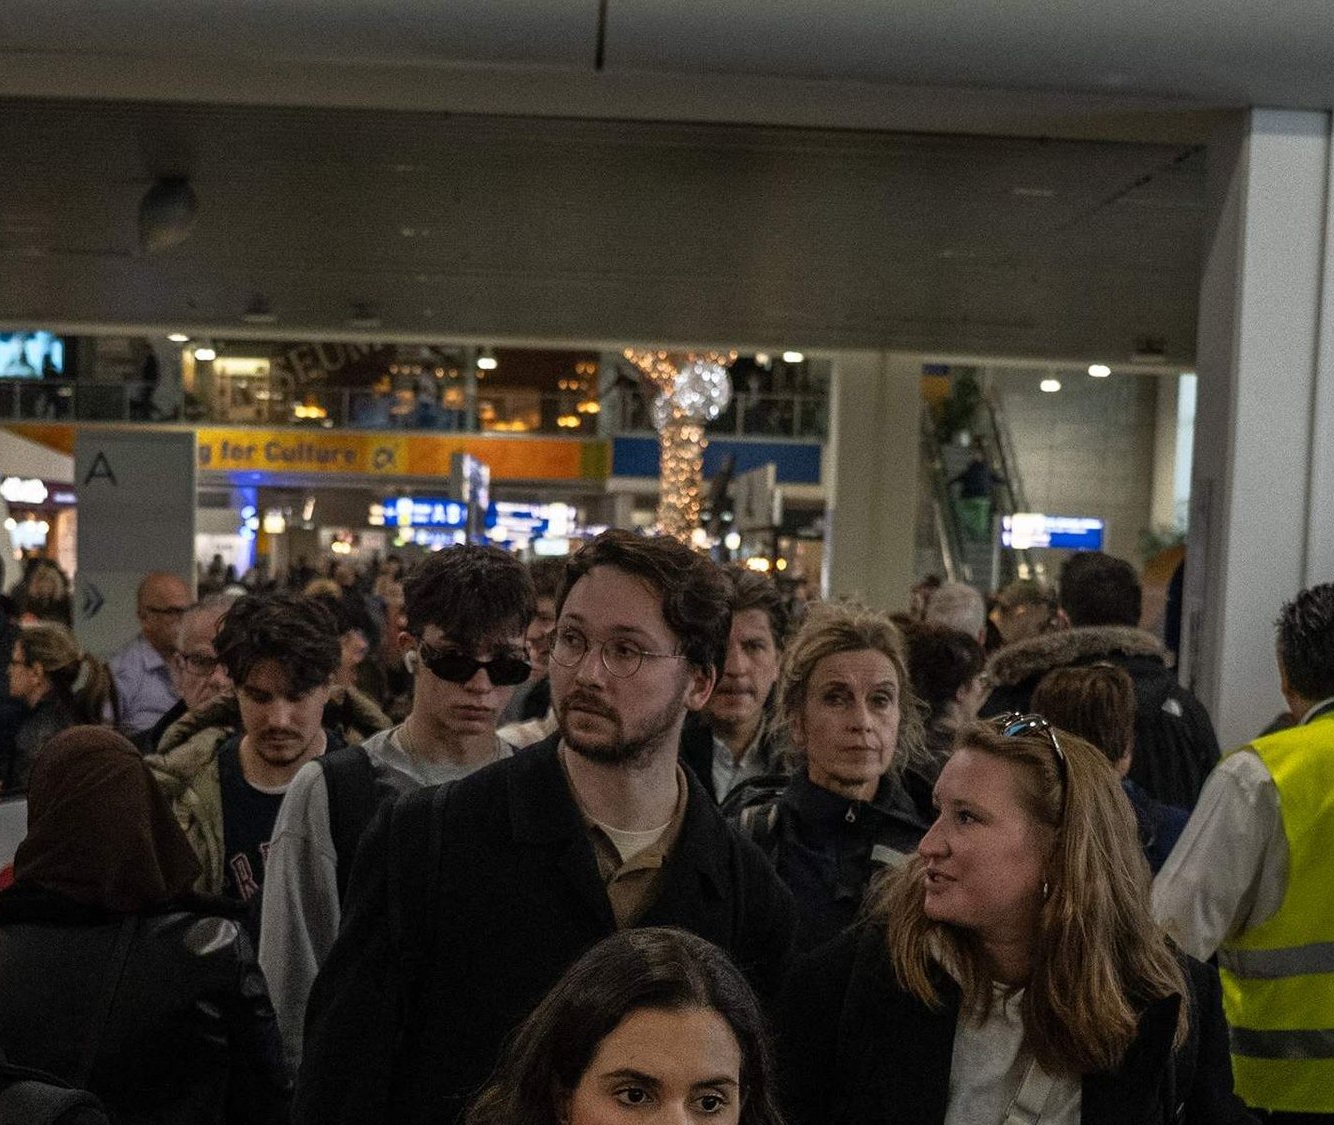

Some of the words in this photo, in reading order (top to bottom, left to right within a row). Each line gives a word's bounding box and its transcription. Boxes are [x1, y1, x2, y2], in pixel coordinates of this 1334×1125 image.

[221, 439, 255, 460] for
[264, 440, 357, 463] Culture
[84, 451, 117, 486] A
